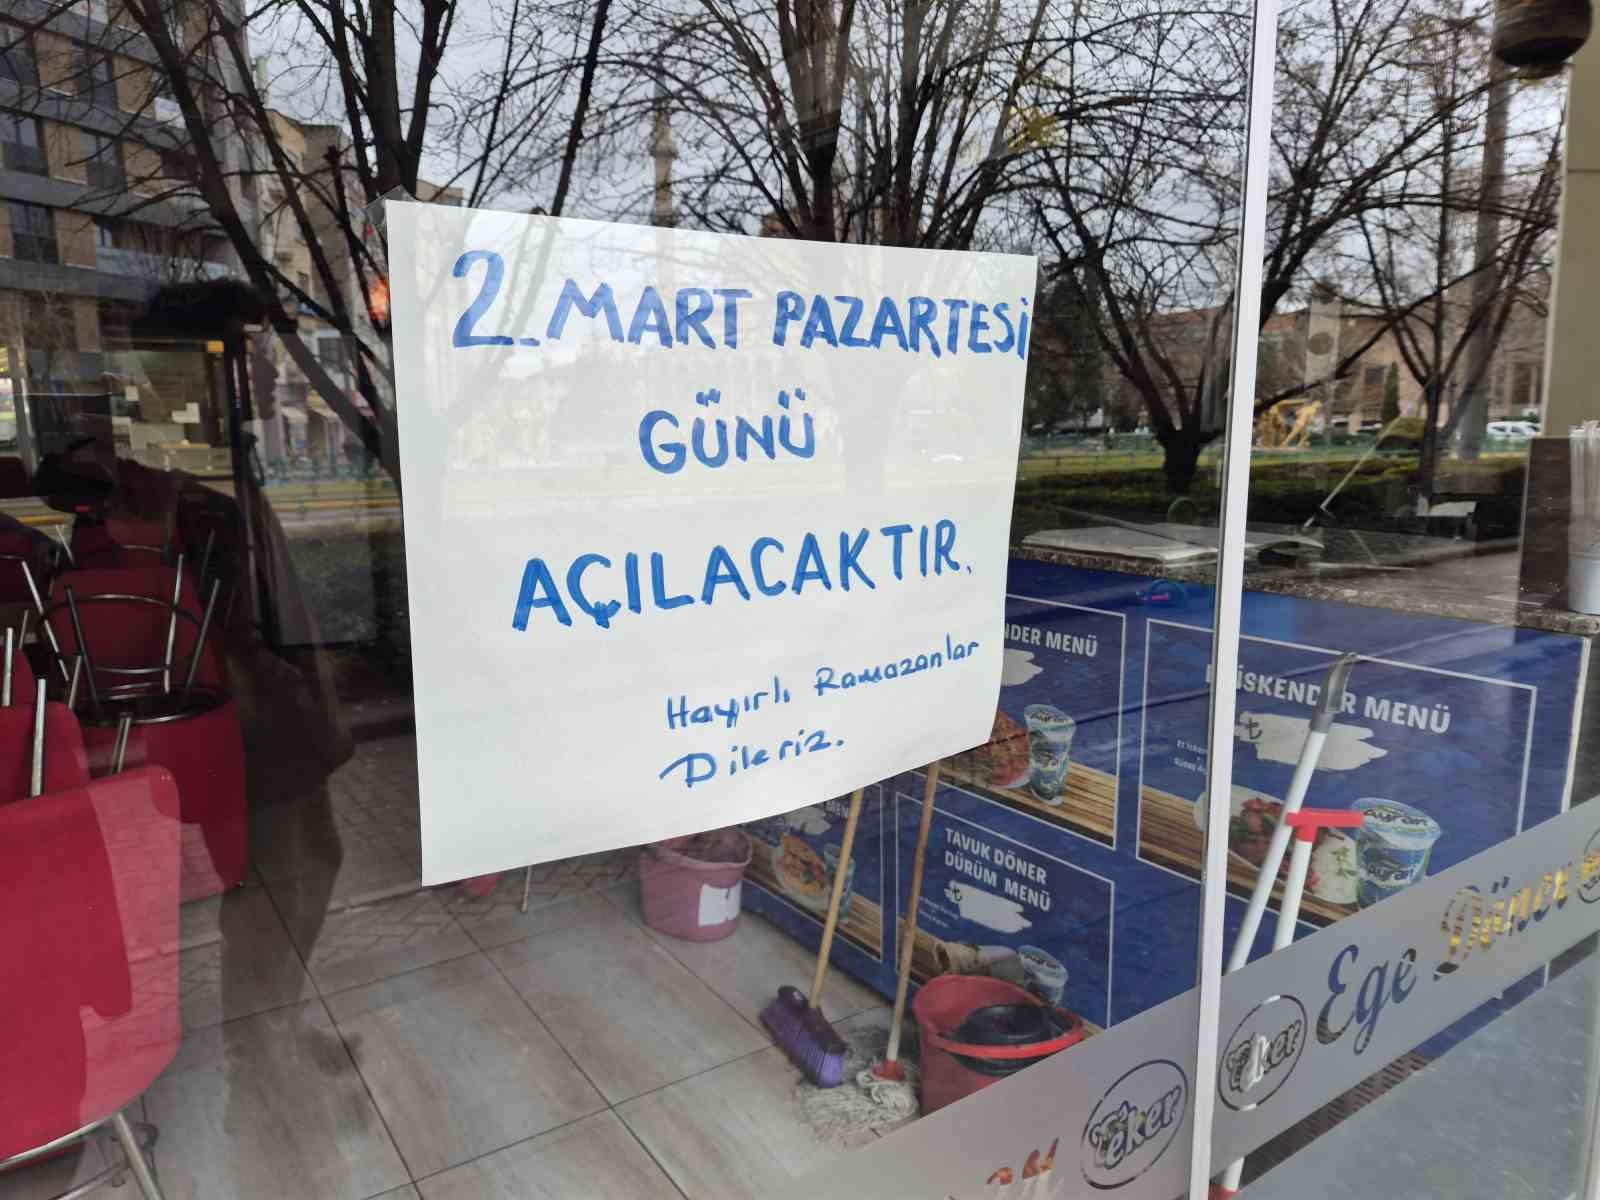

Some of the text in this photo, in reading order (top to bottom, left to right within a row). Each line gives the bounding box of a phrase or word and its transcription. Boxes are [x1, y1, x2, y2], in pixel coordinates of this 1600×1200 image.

[546, 278, 752, 349] MART
[771, 289, 1028, 361] PAZARTESİ
[639, 387, 816, 475] GÜNÜ
[1045, 630, 1098, 657] MENÜ
[1364, 695, 1451, 734] MENÜ
[944, 826, 1047, 886] TAVUK DÖNER
[944, 850, 997, 888] DÜRÜM
[1004, 877, 1051, 912] MENÜ
[1316, 944, 1418, 1057] Ege
